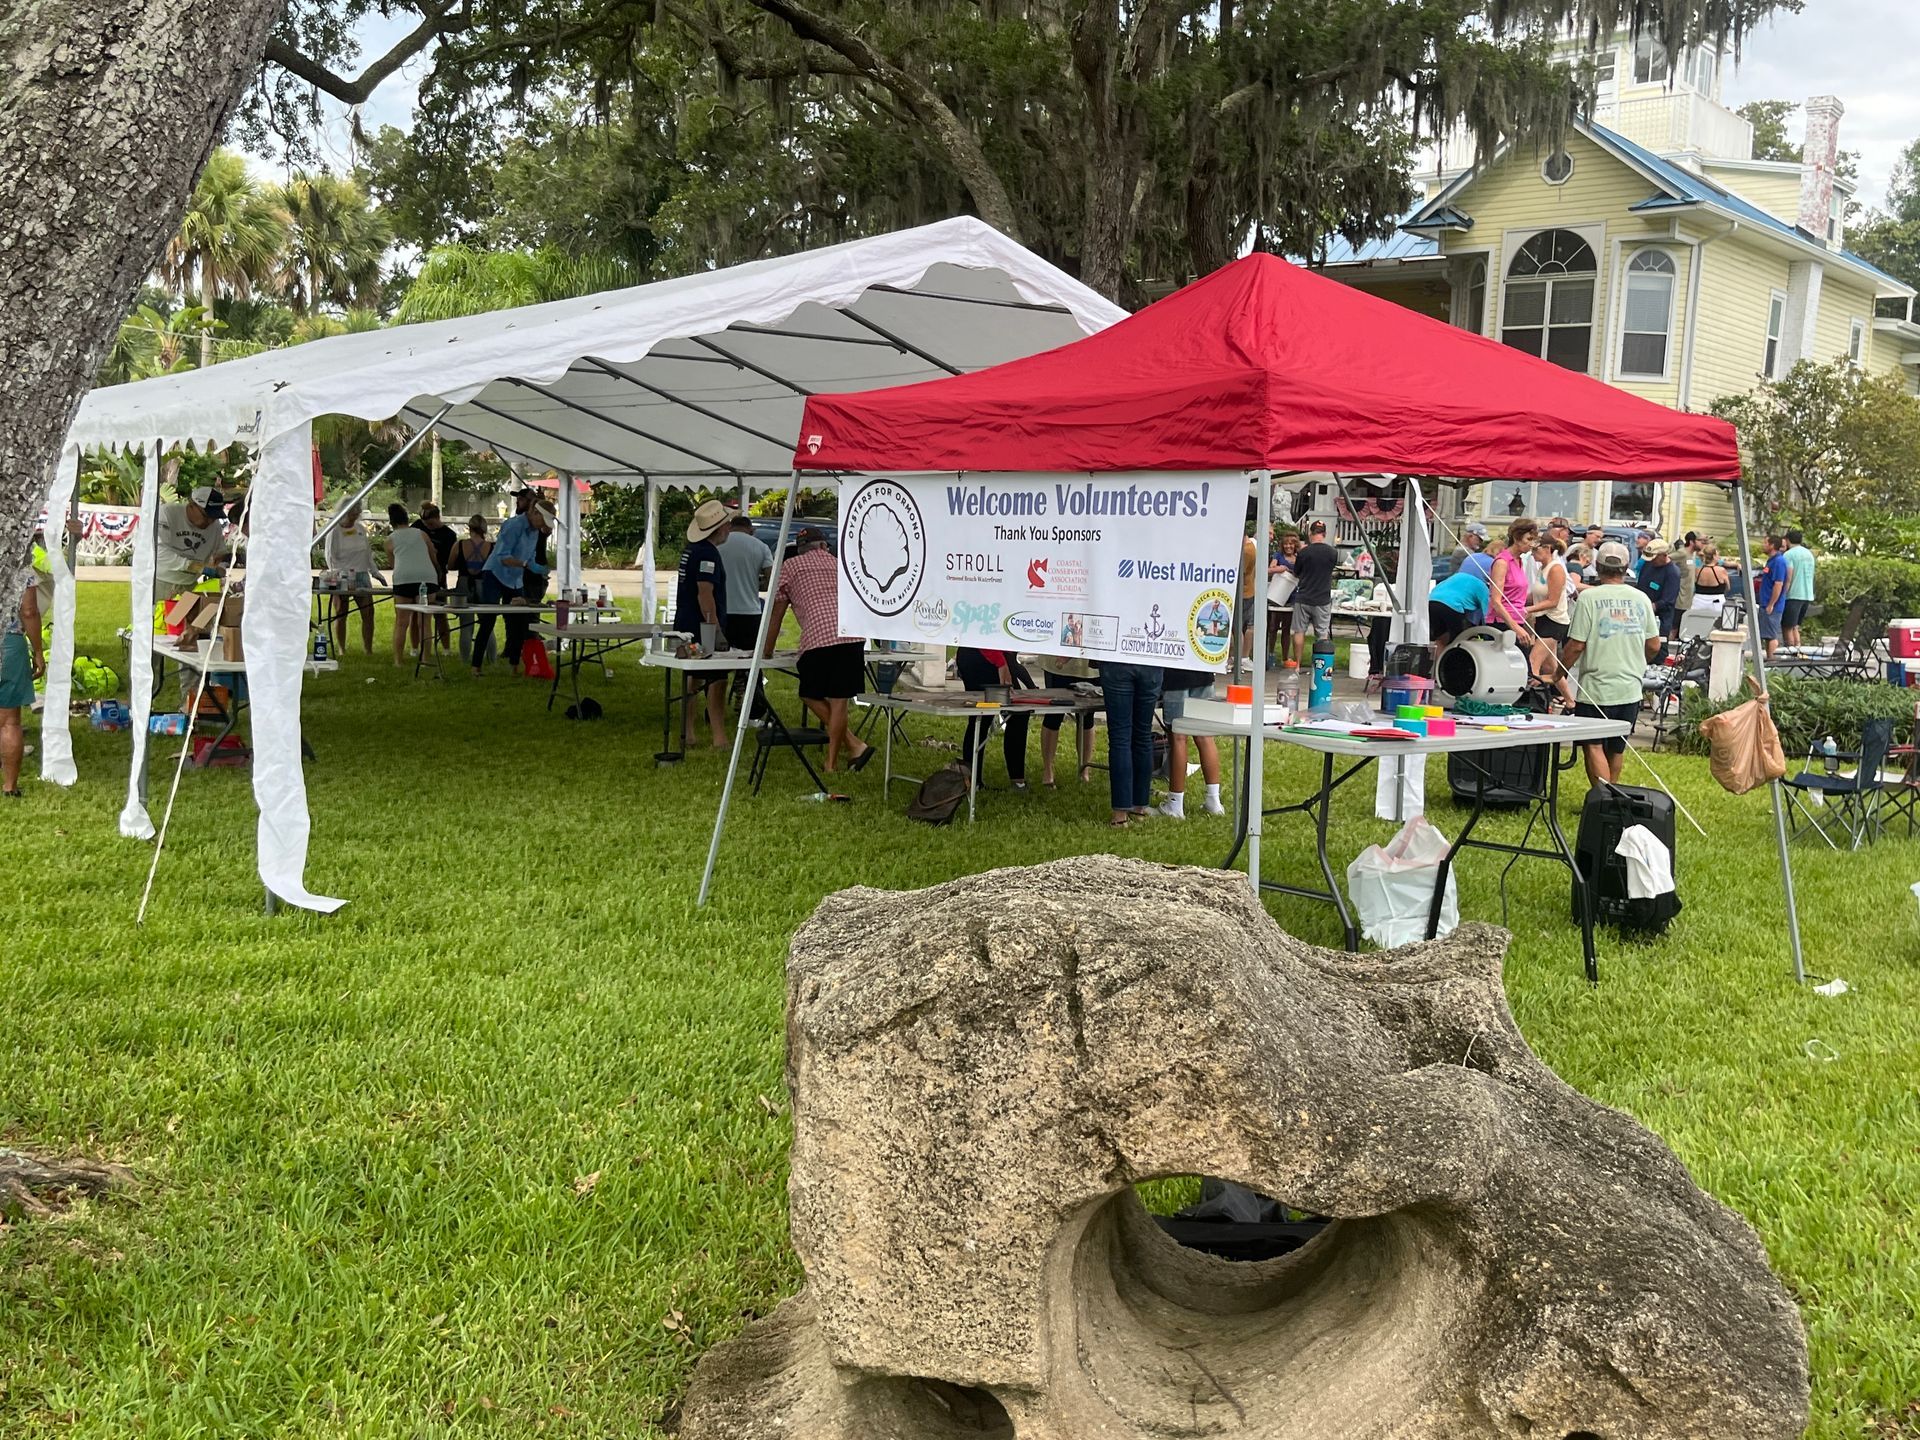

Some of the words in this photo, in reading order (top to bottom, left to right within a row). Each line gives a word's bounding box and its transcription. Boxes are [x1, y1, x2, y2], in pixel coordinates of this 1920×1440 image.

[946, 485, 1047, 516] Welcome
[1055, 482, 1210, 517] Volunteers!
[848, 491, 872, 539] OYSTERS
[875, 487, 892, 497] FOR
[895, 492, 920, 540] ORMOND
[994, 525, 1026, 541] Thank
[1028, 526, 1049, 541] You
[1051, 526, 1102, 545] Sponsors
[946, 553, 1004, 572] STROLL
[1137, 560, 1176, 581] West
[1180, 562, 1236, 584] Marine
[851, 561, 869, 595] CLEANING
[870, 594, 880, 604] THE
[882, 598, 896, 606] RIVER
[898, 564, 919, 600] NATURALLY
[1197, 593, 1210, 605] DECK
[1217, 592, 1230, 602] DOCK
[1595, 599, 1614, 609] LIVE
[1616, 599, 1633, 608] LIFE
[952, 600, 1001, 634] Spas
[1010, 616, 1034, 628] Carpet
[1035, 618, 1054, 629] Color
[1610, 608, 1627, 618] LIKE
[1629, 609, 1634, 617] A
[1164, 630, 1178, 638] 1987
[1121, 638, 1146, 652] CUSTOM
[1146, 641, 1164, 654] BUILT
[1164, 643, 1185, 656] DOCKS
[1189, 630, 1208, 660] EVERYTHING
